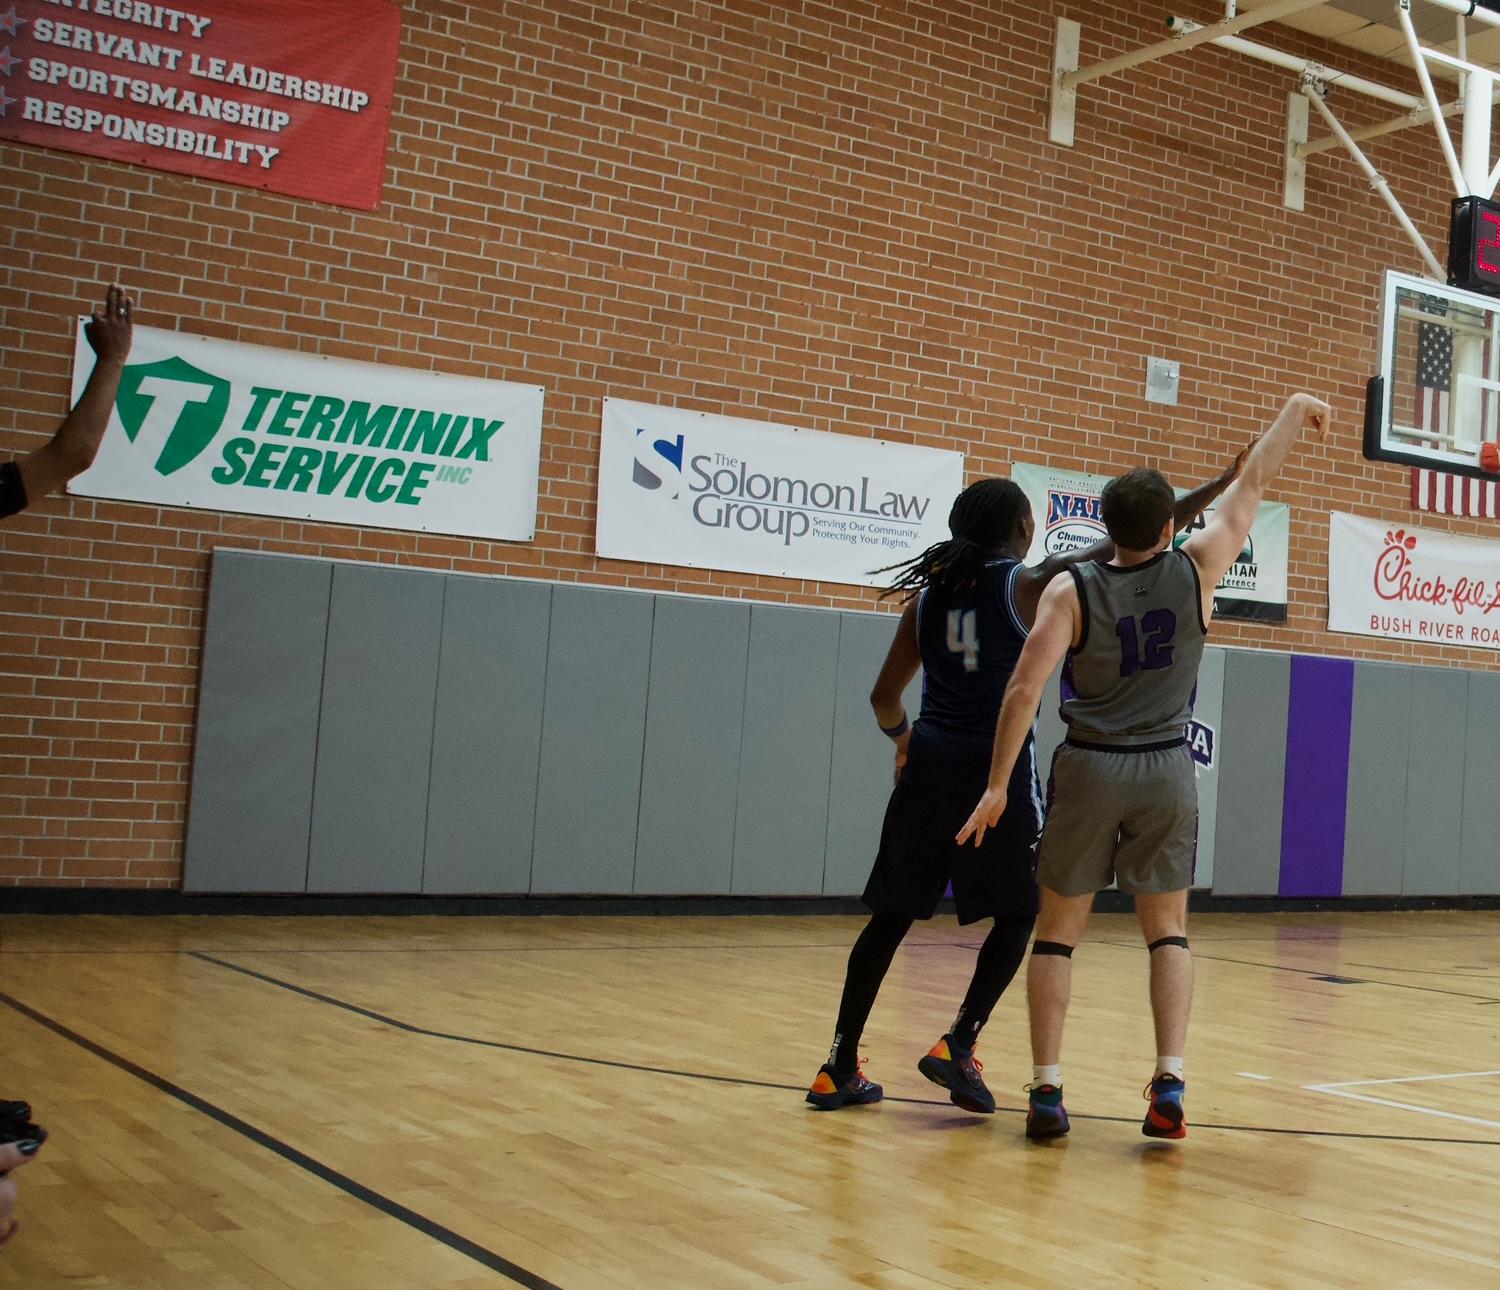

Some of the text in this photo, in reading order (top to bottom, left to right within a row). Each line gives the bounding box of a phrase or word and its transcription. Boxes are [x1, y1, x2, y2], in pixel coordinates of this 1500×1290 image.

[43, 0, 211, 38] TEGRITY
[33, 18, 369, 112] SERVANT LEADERSHIP
[28, 58, 291, 132] SPORTSMANSHIP
[22, 96, 280, 169] RESPONSIBILITY
[241, 386, 505, 462] TERMINIX
[211, 437, 437, 506] SERVICE
[436, 464, 473, 485] INC
[688, 455, 931, 521] Solomon Law
[714, 453, 738, 468] The
[692, 494, 810, 546] Group
[813, 516, 846, 531] Serving
[849, 521, 865, 532] Our
[1048, 493, 1105, 524] NAI
[812, 529, 911, 549] Protecting Your Rights.
[946, 608, 980, 673] 4
[1115, 608, 1177, 678] 12
[1370, 615, 1412, 634] BUSH
[1419, 620, 1464, 640] RIVER
